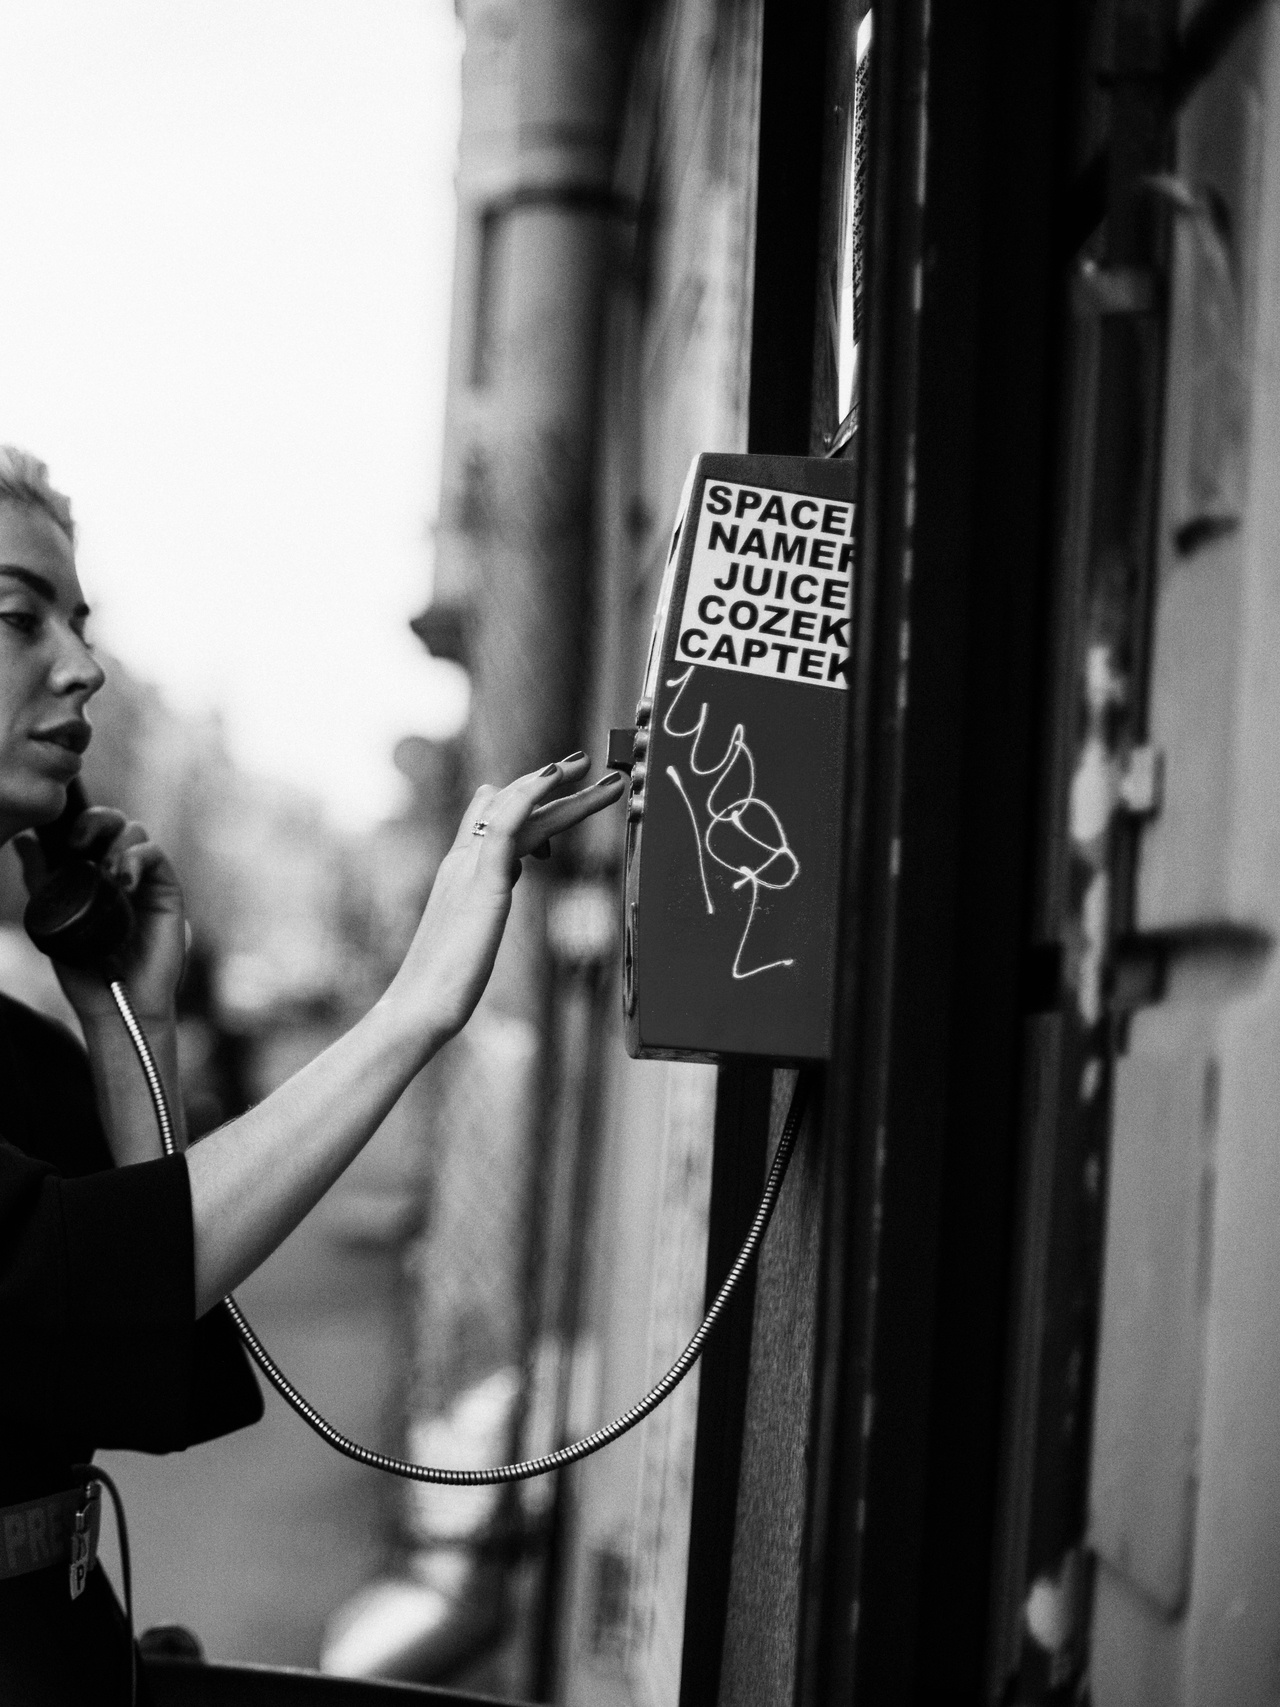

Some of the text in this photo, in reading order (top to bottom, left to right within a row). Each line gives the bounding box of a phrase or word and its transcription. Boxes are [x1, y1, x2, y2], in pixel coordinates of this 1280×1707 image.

[706, 485, 854, 537] SPACE
[714, 562, 849, 610] JUICE
[698, 595, 851, 648] COZEK
[679, 628, 851, 682] CAPTEK
